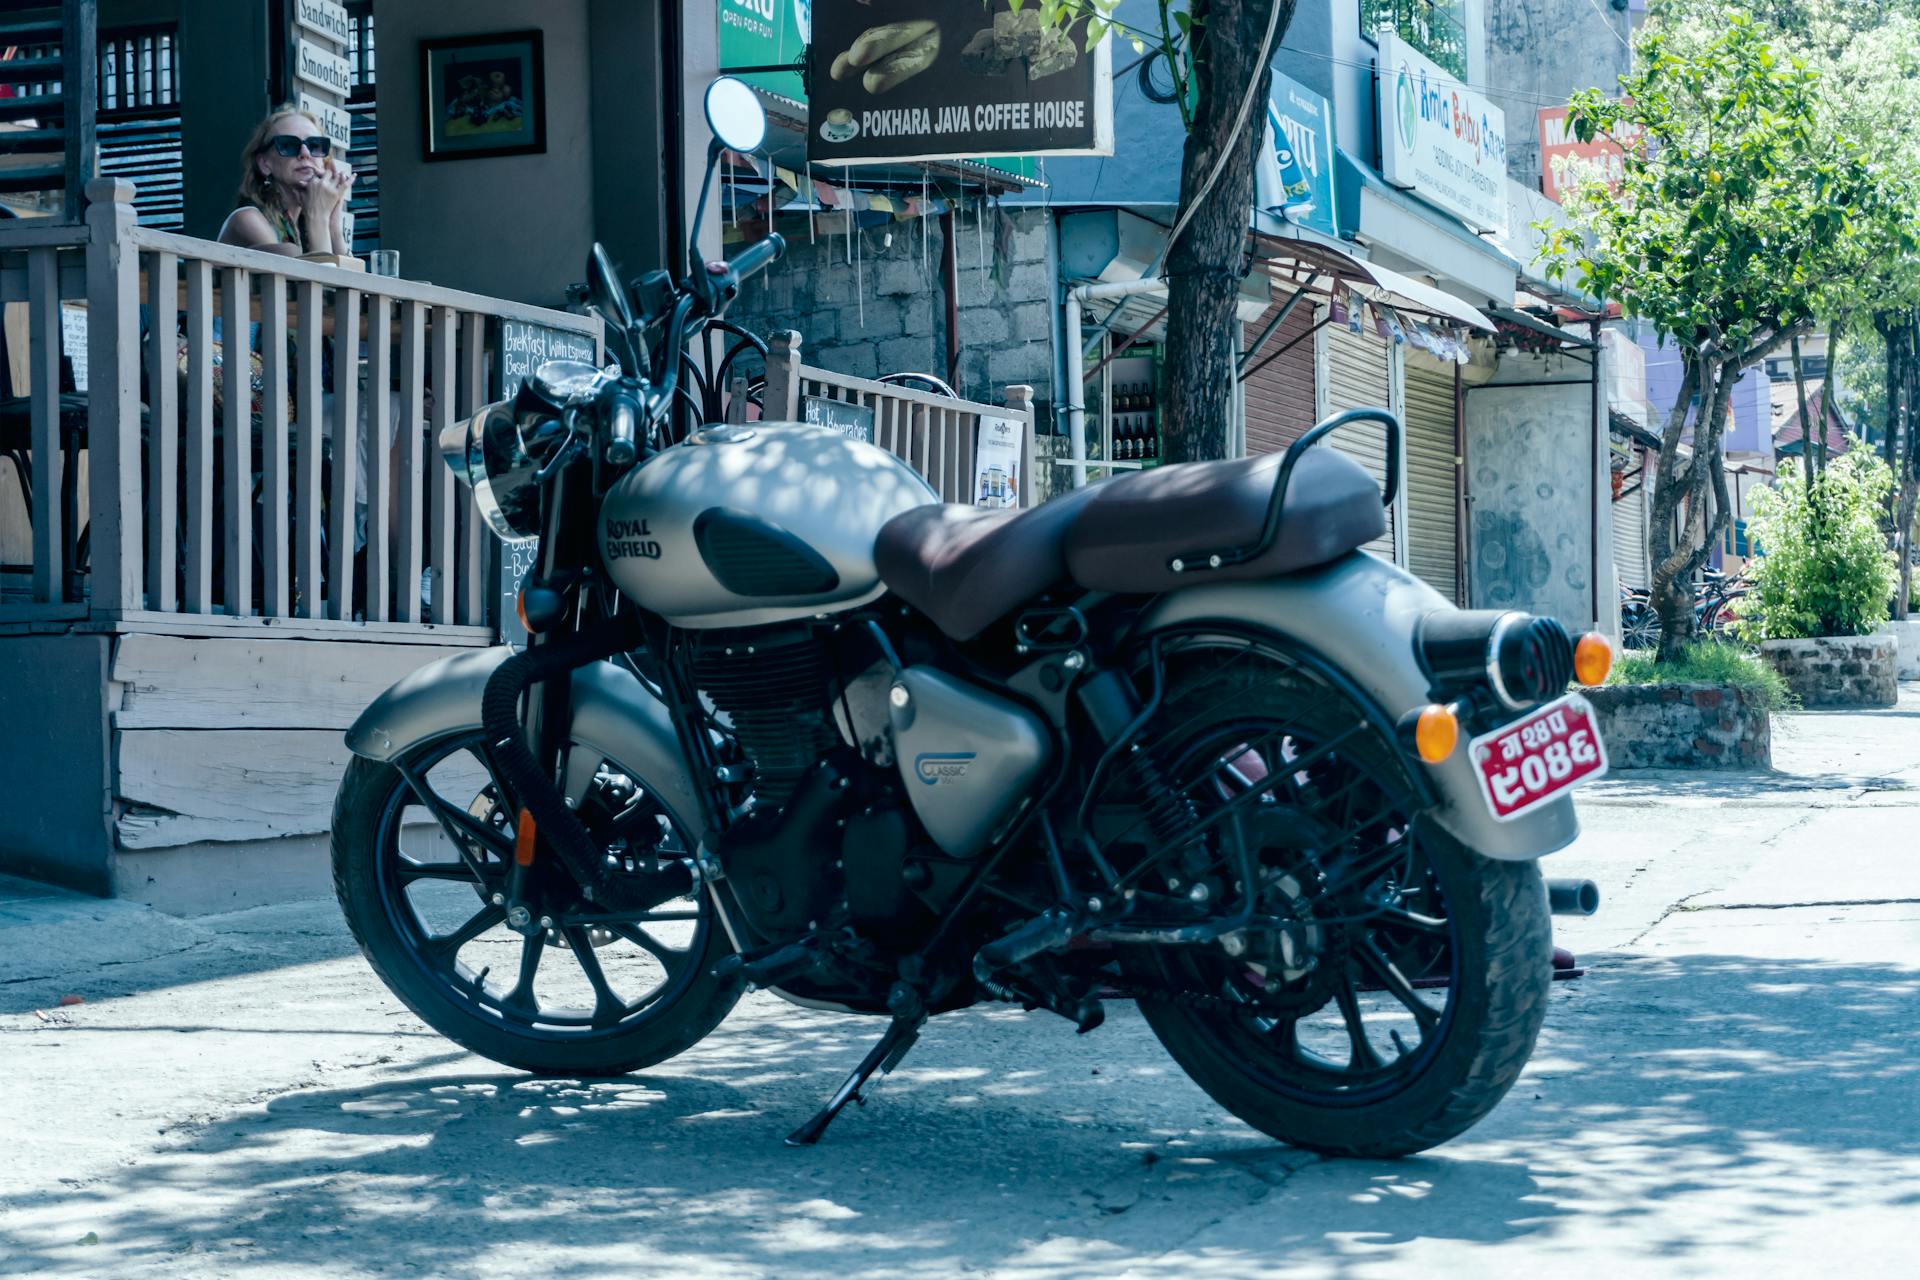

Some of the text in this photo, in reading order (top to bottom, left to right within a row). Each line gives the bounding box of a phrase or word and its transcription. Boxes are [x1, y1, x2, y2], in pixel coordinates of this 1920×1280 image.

[301, 0, 347, 38] Sandwich
[722, 9, 743, 29] OPEN
[744, 18, 760, 34] FOR
[759, 23, 773, 39] FUN
[302, 46, 348, 90] Smoothie
[862, 100, 1084, 137] POKHARA JAVA COFFEE HOUSE
[1452, 90, 1481, 166] Baby
[1482, 112, 1506, 164] Care
[505, 353, 530, 376] Based
[805, 399, 820, 422] Hot
[606, 518, 651, 540] ROYAL
[607, 540, 662, 561] ENFIELD
